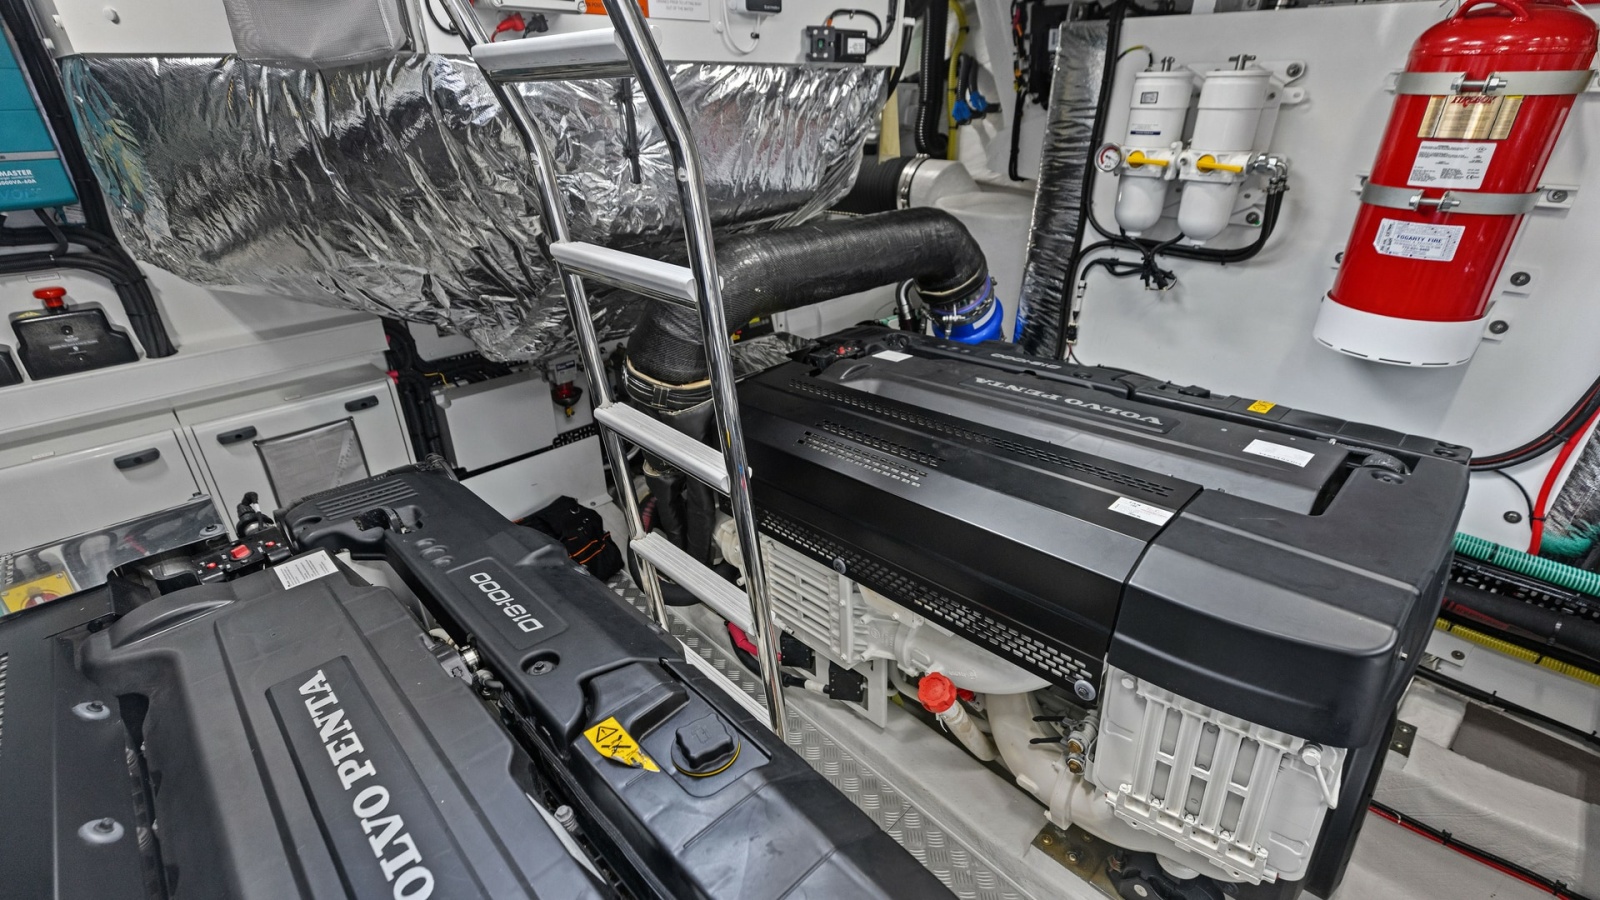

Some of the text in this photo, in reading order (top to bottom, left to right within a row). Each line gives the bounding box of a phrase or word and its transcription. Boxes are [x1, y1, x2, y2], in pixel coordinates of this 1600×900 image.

[975, 376, 1163, 426] VOLVO PENTA
[469, 572, 544, 633] D13-1000
[298, 669, 377, 791] PENTA
[352, 785, 435, 900] OLVO
